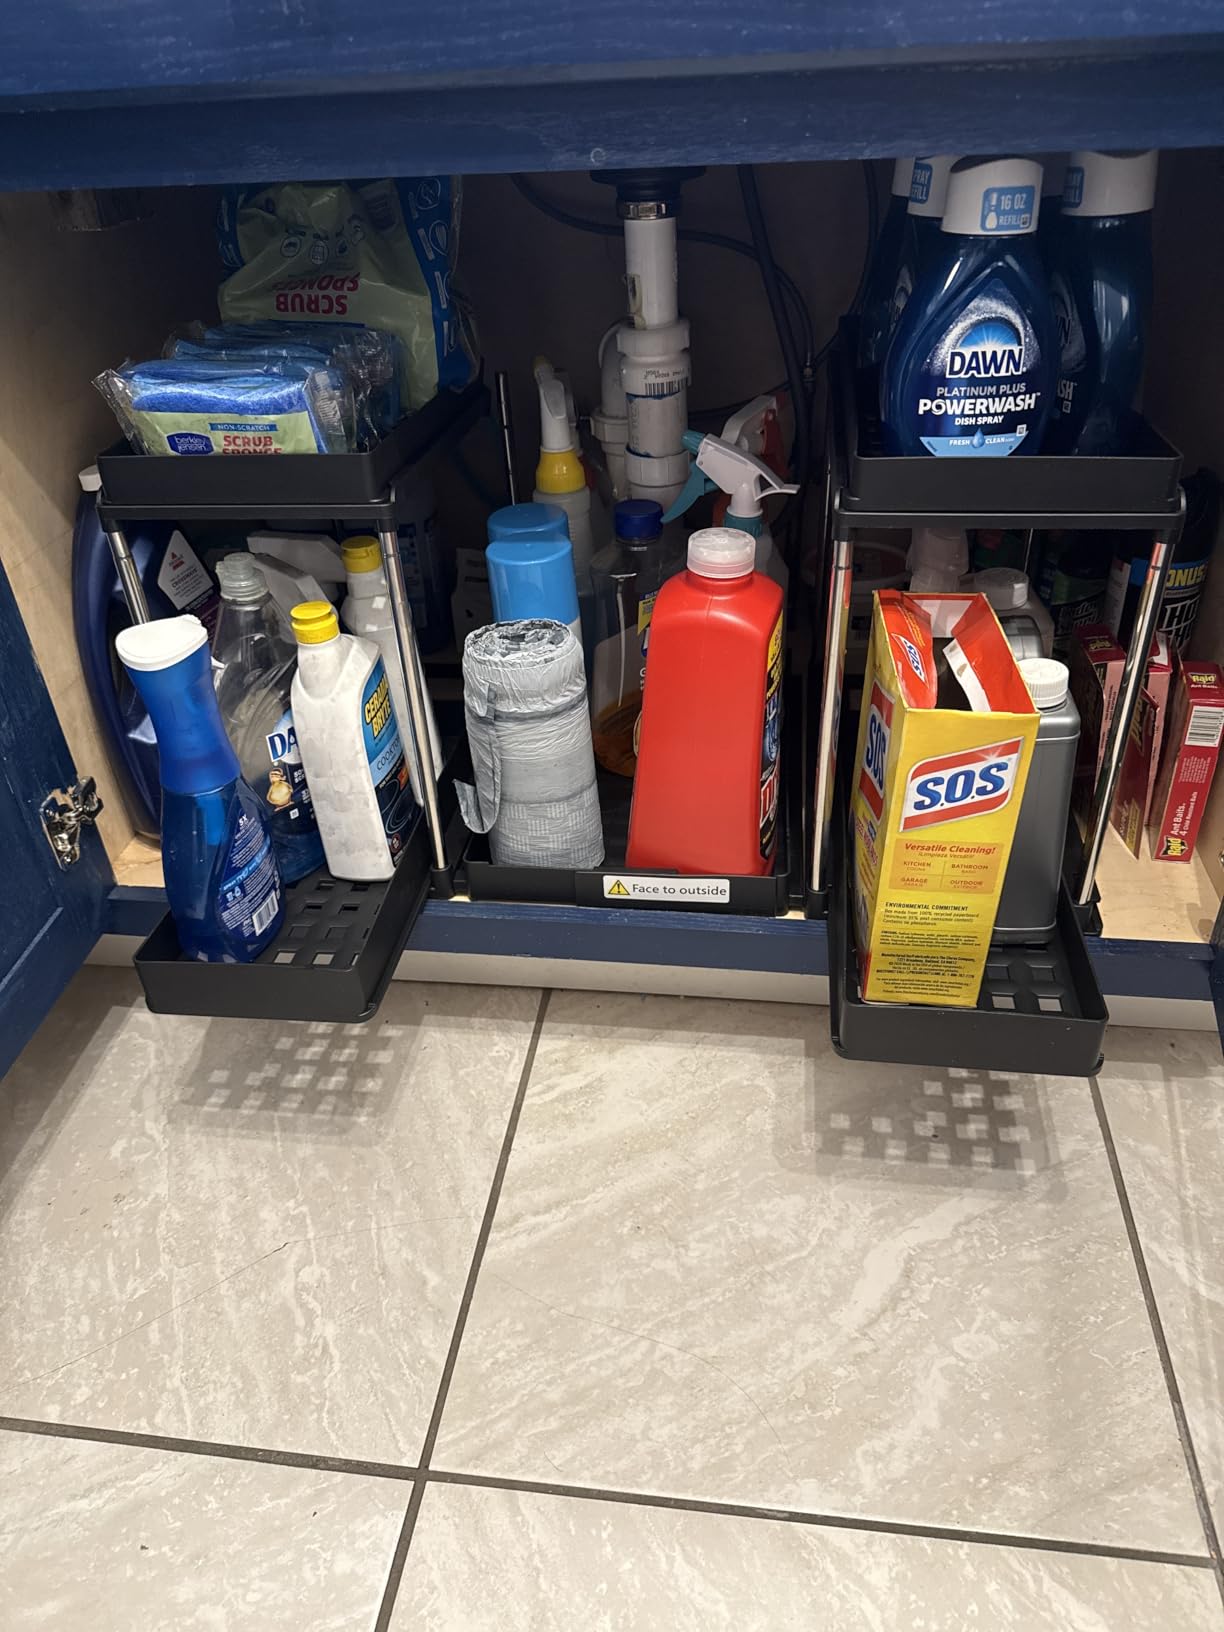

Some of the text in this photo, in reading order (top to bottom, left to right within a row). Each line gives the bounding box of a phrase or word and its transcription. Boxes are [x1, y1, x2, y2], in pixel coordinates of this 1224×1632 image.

[913, 169, 929, 184] PRAY
[1001, 194, 1026, 210] 16 OZ
[275, 294, 348, 316] SCRUB
[946, 348, 1024, 378] DAWN
[937, 383, 1026, 397] PLATINUM PLUS
[955, 415, 1004, 425] DISH SPRAY
[223, 435, 273, 449] SCRUB
[985, 437, 1005, 445] CLEAN
[1166, 564, 1205, 587] ONUS
[1192, 674, 1215, 684] Raid
[376, 737, 400, 771] COOKTO
[913, 761, 1009, 811] S.O.S
[1170, 822, 1181, 836] Ant
[905, 843, 996, 855] Versatile Cleaning!
[1167, 838, 1182, 856] Raid
[632, 884, 727, 896] Face to outside
[885, 902, 930, 910] ENVIRONMENTAL
